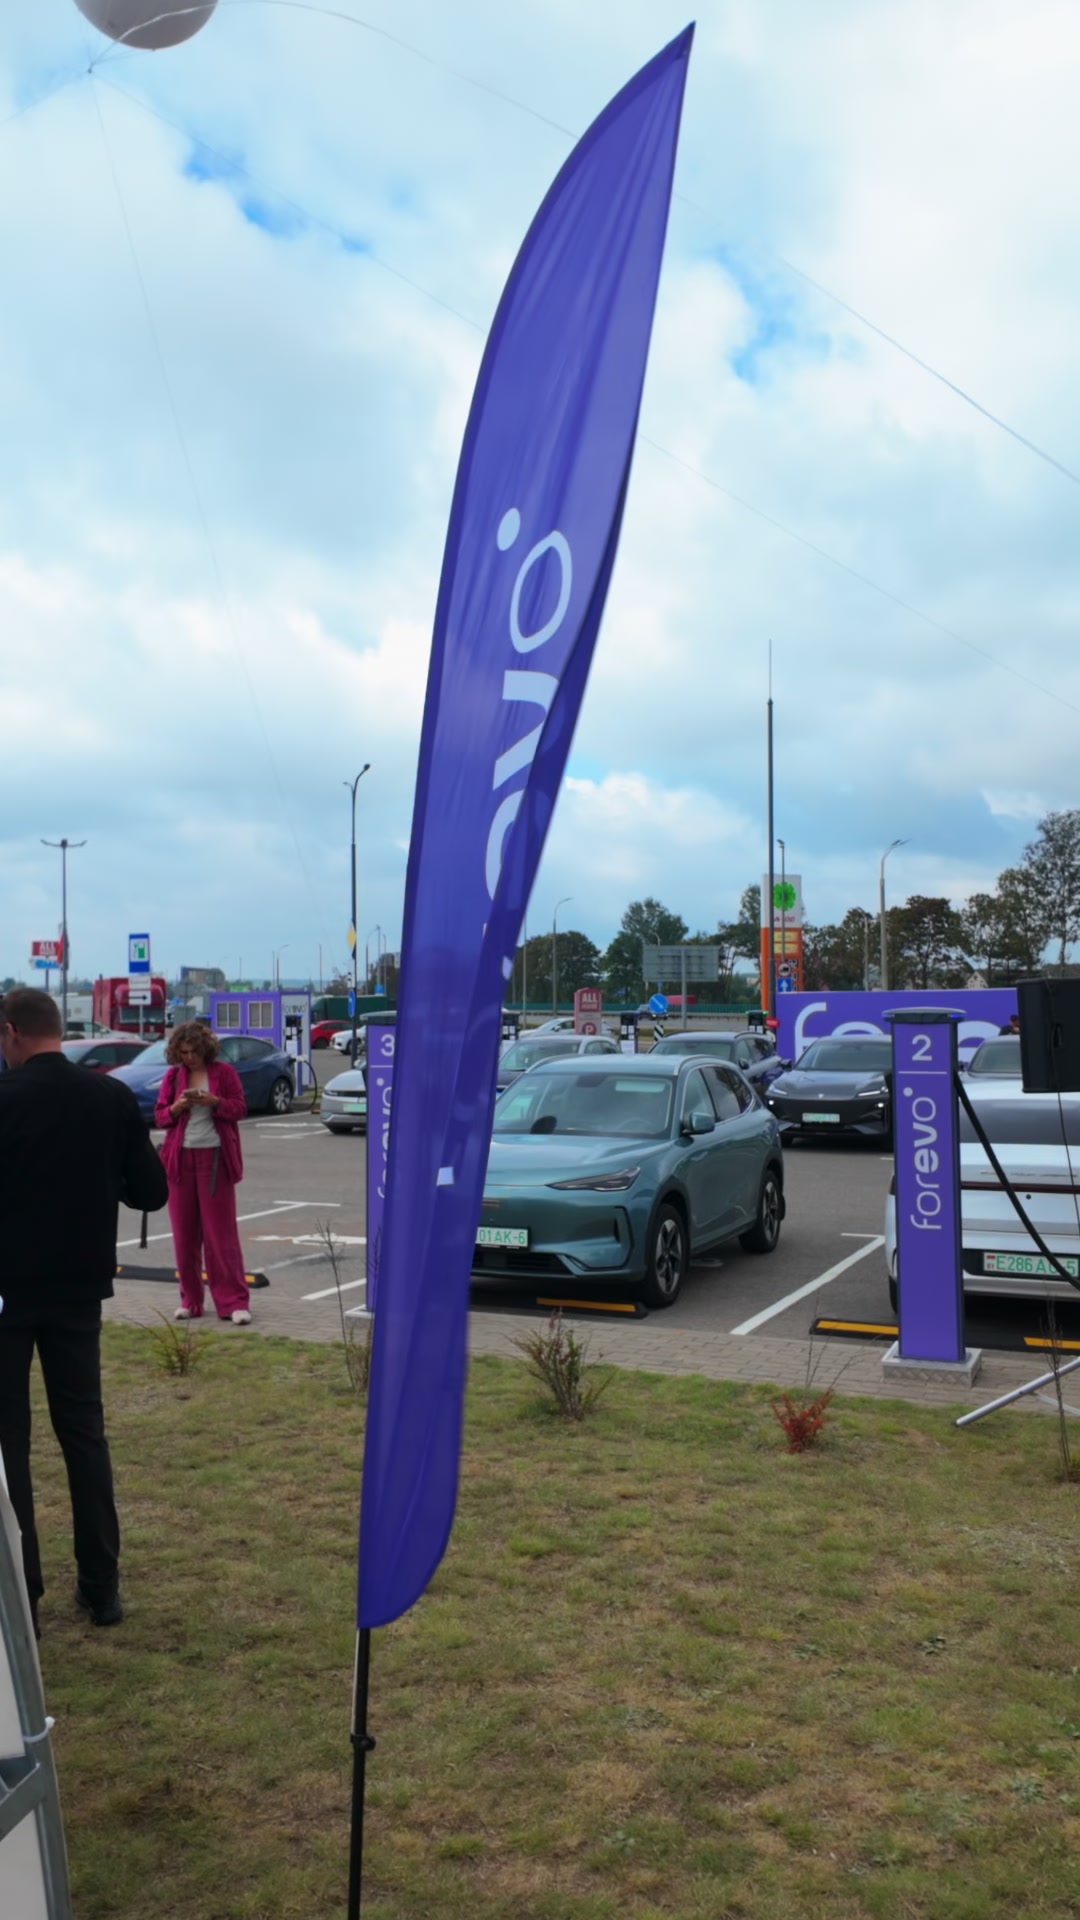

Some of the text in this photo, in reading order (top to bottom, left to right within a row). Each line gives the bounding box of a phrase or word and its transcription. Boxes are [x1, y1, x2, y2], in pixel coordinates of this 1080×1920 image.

[582, 993, 598, 1003] ALL
[381, 1034, 395, 1057] 3
[911, 1034, 933, 1061] 2
[910, 1096, 942, 1231] forevo
